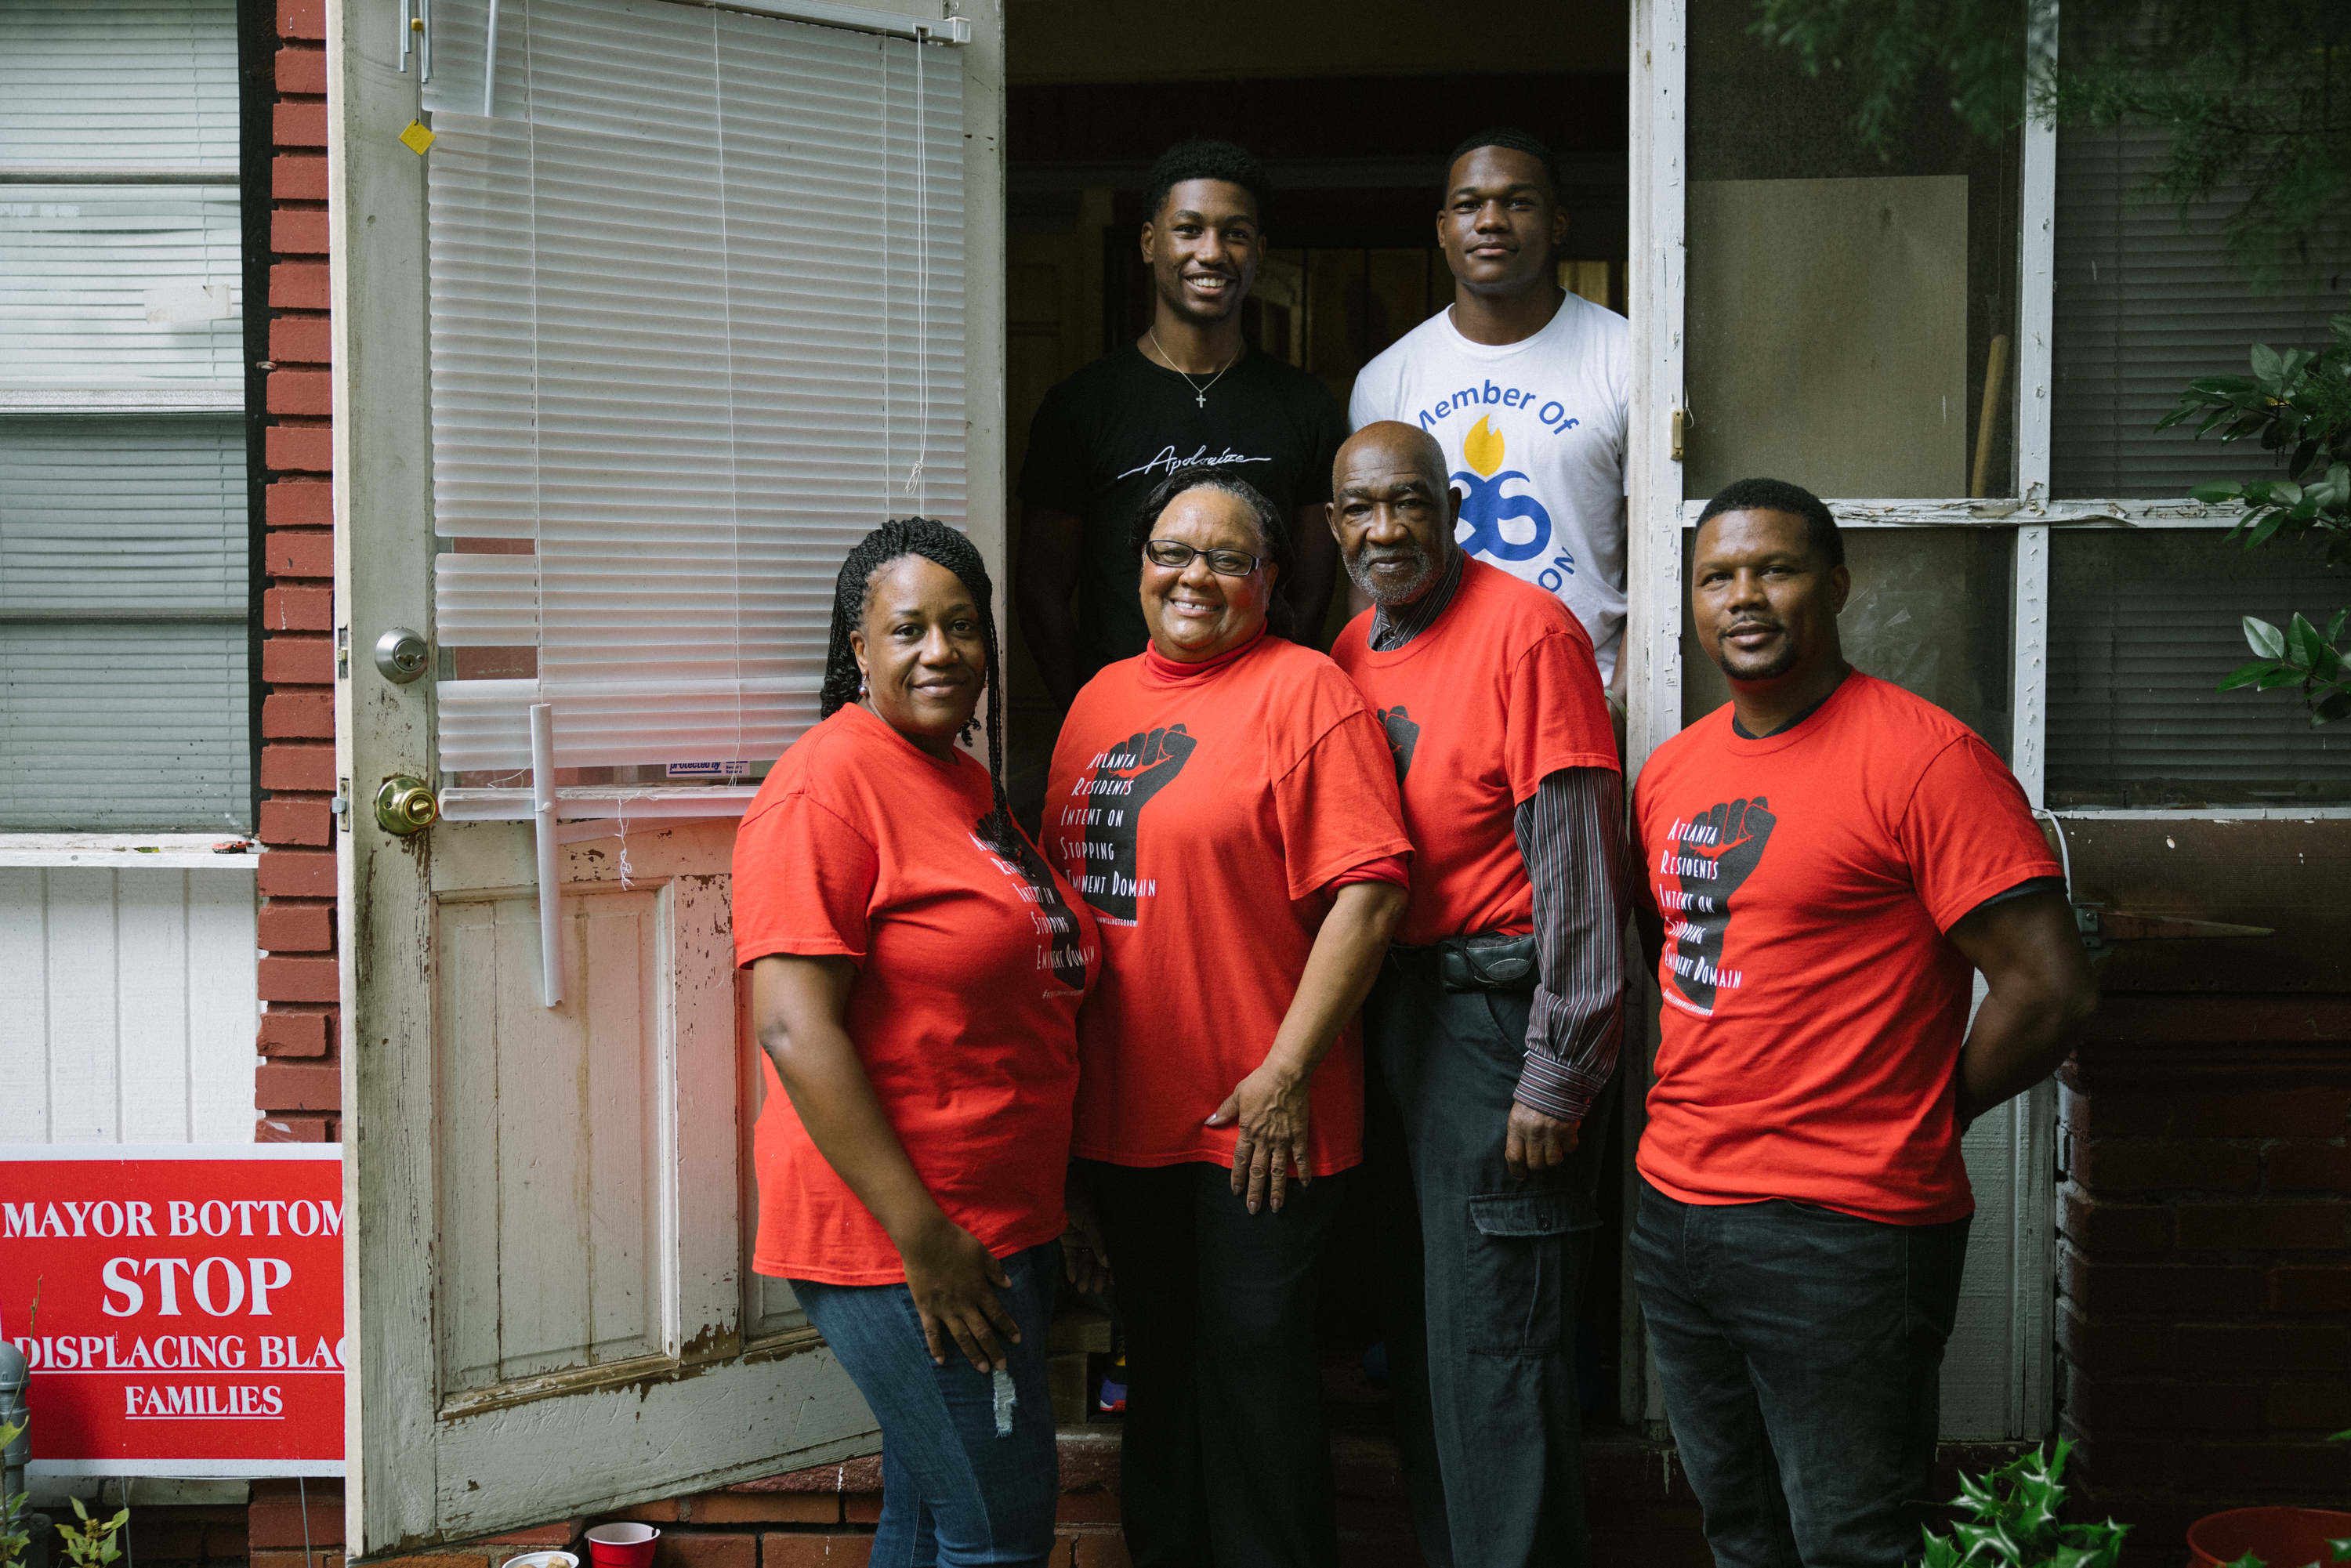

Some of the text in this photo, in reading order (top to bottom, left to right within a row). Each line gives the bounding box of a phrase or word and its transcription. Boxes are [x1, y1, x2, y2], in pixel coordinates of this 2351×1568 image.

[1539, 401, 1579, 435] Of
[1086, 751, 1136, 770] ATLANTA
[1071, 777, 1134, 795] RESIDENTS
[1061, 805, 1124, 827] INTENT ON
[1667, 817, 1718, 844] ATLANTA
[1060, 836, 1114, 860] STOPPING
[1661, 849, 1719, 880] RESIDENTS
[1112, 871, 1155, 896] DOMAIN
[1659, 883, 1694, 911] INTENT
[1694, 956, 1741, 989] DOMAIN
[2, 1200, 157, 1238] MAYOR
[102, 1257, 292, 1316] STOP
[13, 1335, 246, 1369] DISPLACING
[125, 1385, 283, 1415] FAMILIES
